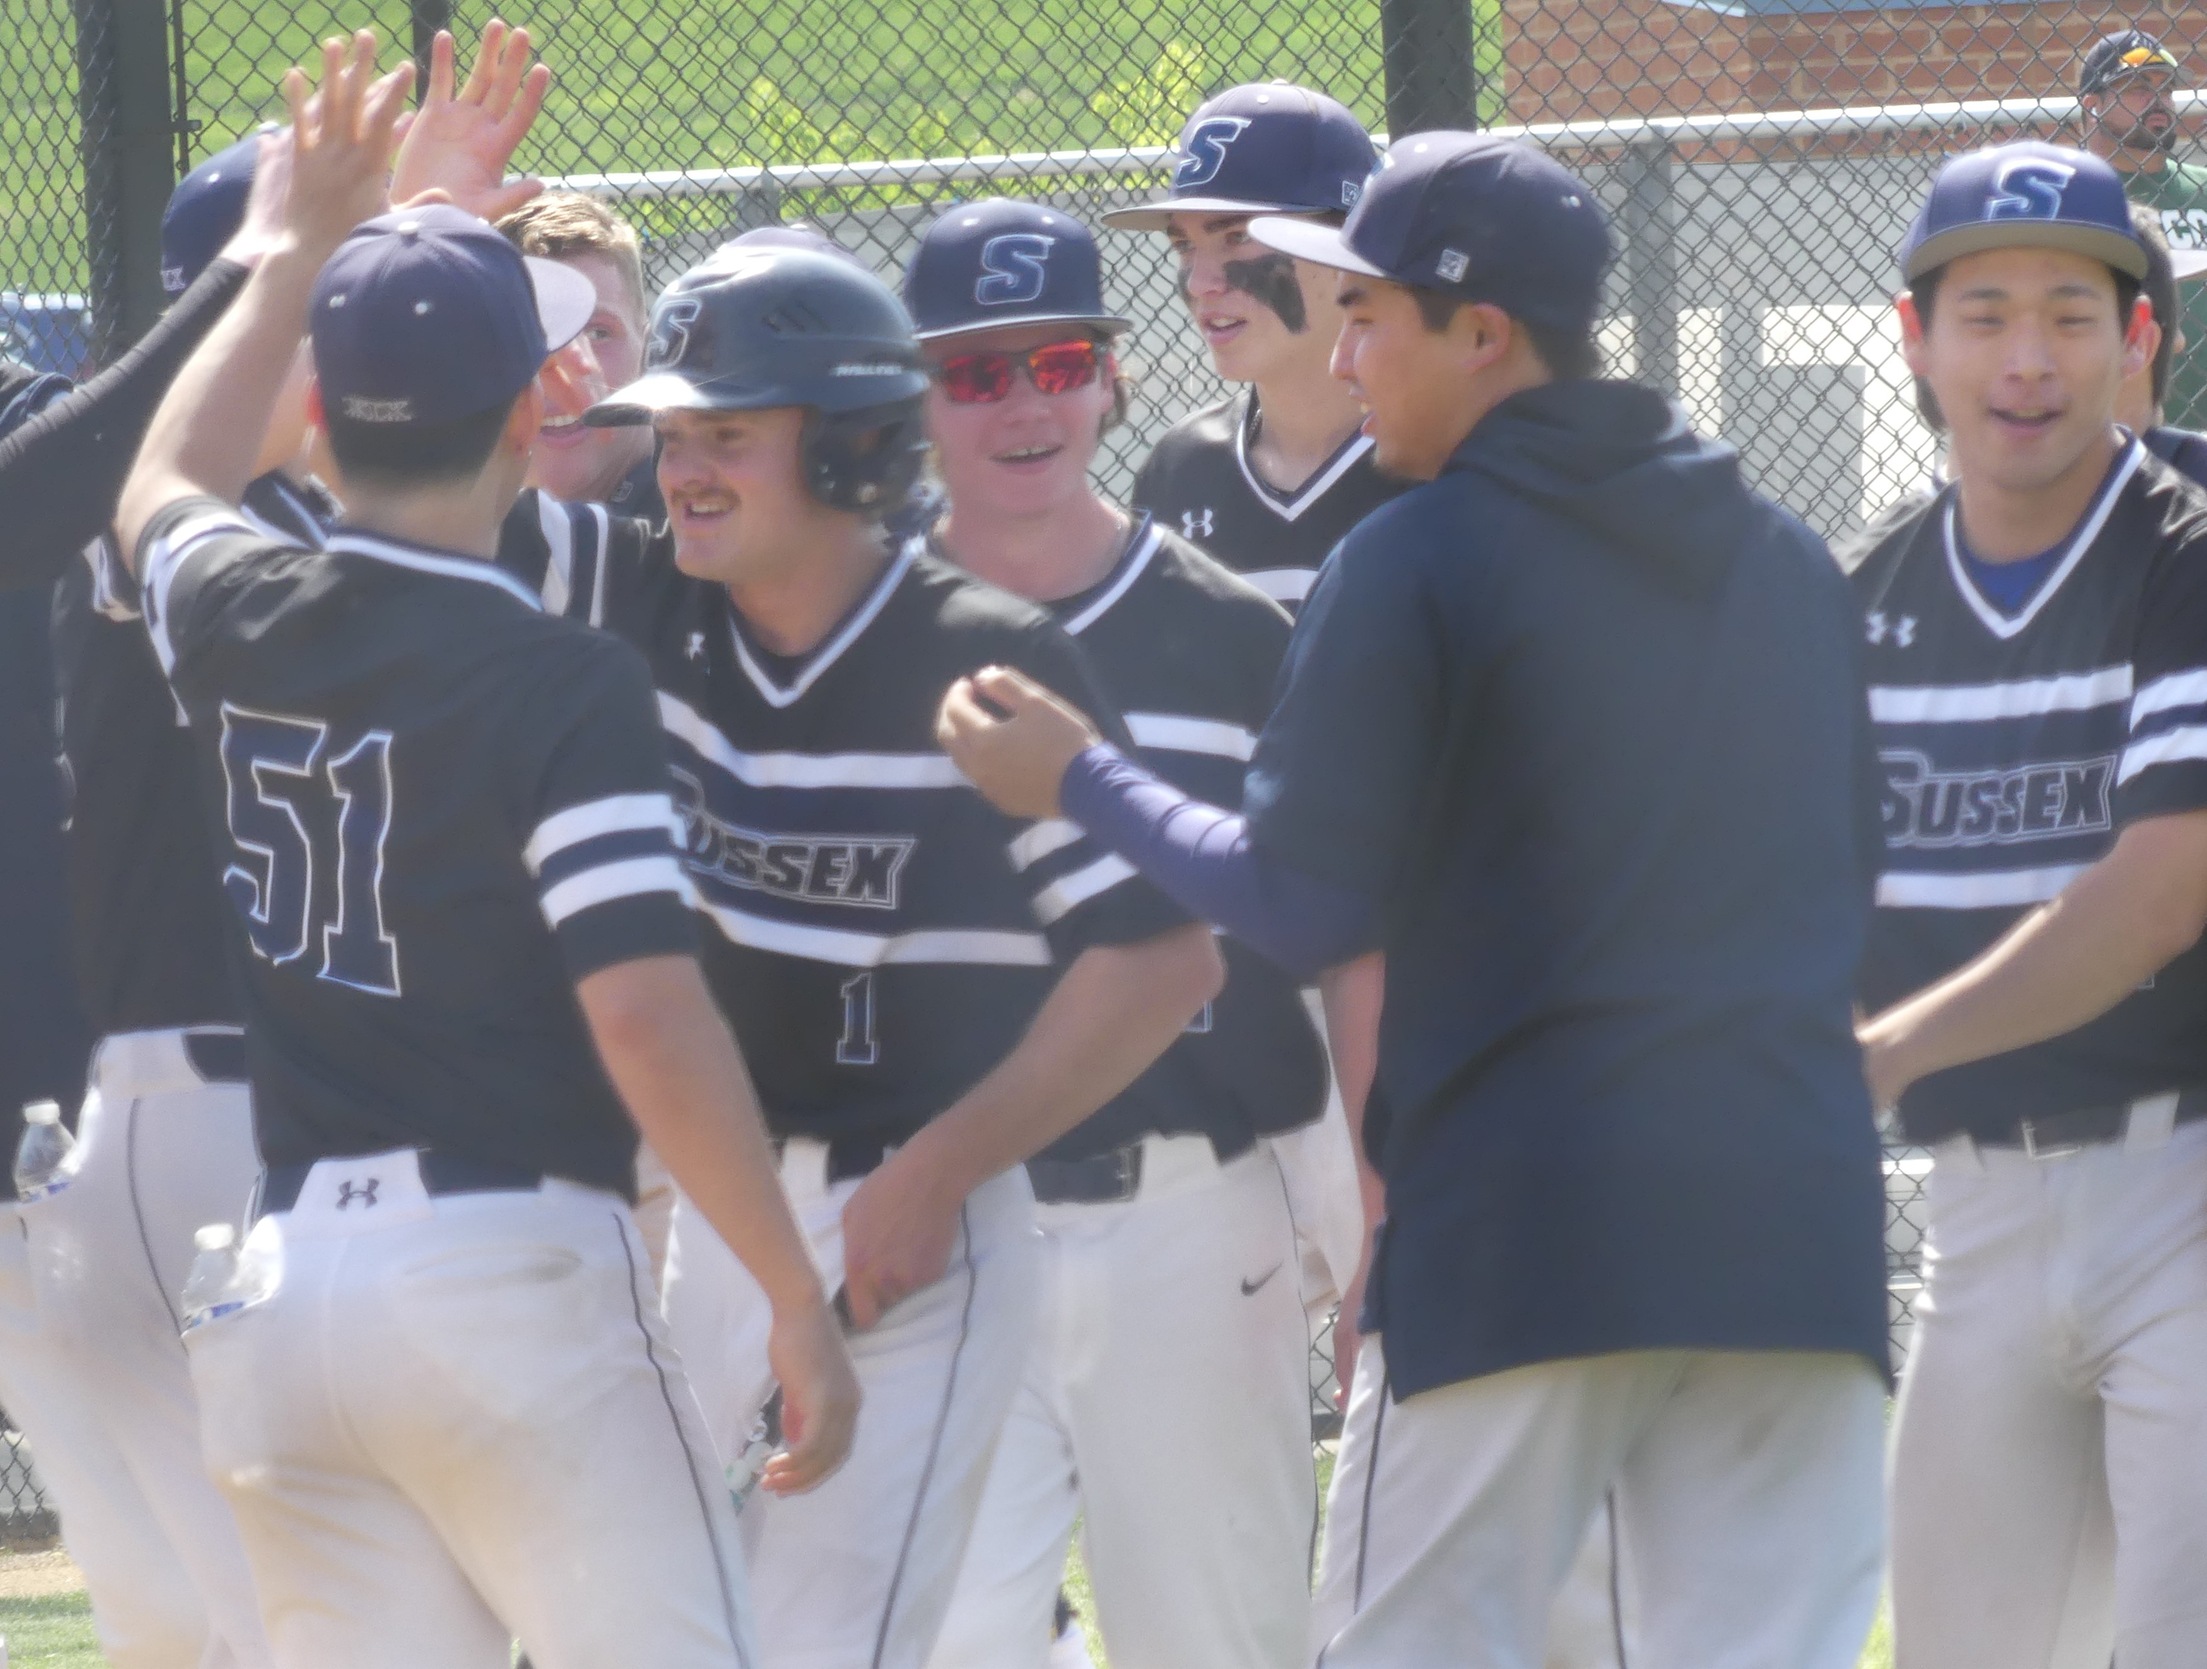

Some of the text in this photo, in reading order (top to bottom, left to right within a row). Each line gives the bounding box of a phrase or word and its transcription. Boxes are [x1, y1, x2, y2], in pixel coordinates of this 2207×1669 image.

[1175, 117, 1252, 188] S
[1986, 160, 2076, 221] S
[976, 233, 1055, 305] S
[646, 298, 702, 371] S
[219, 701, 401, 997] 51
[836, 971, 876, 1064] 1
